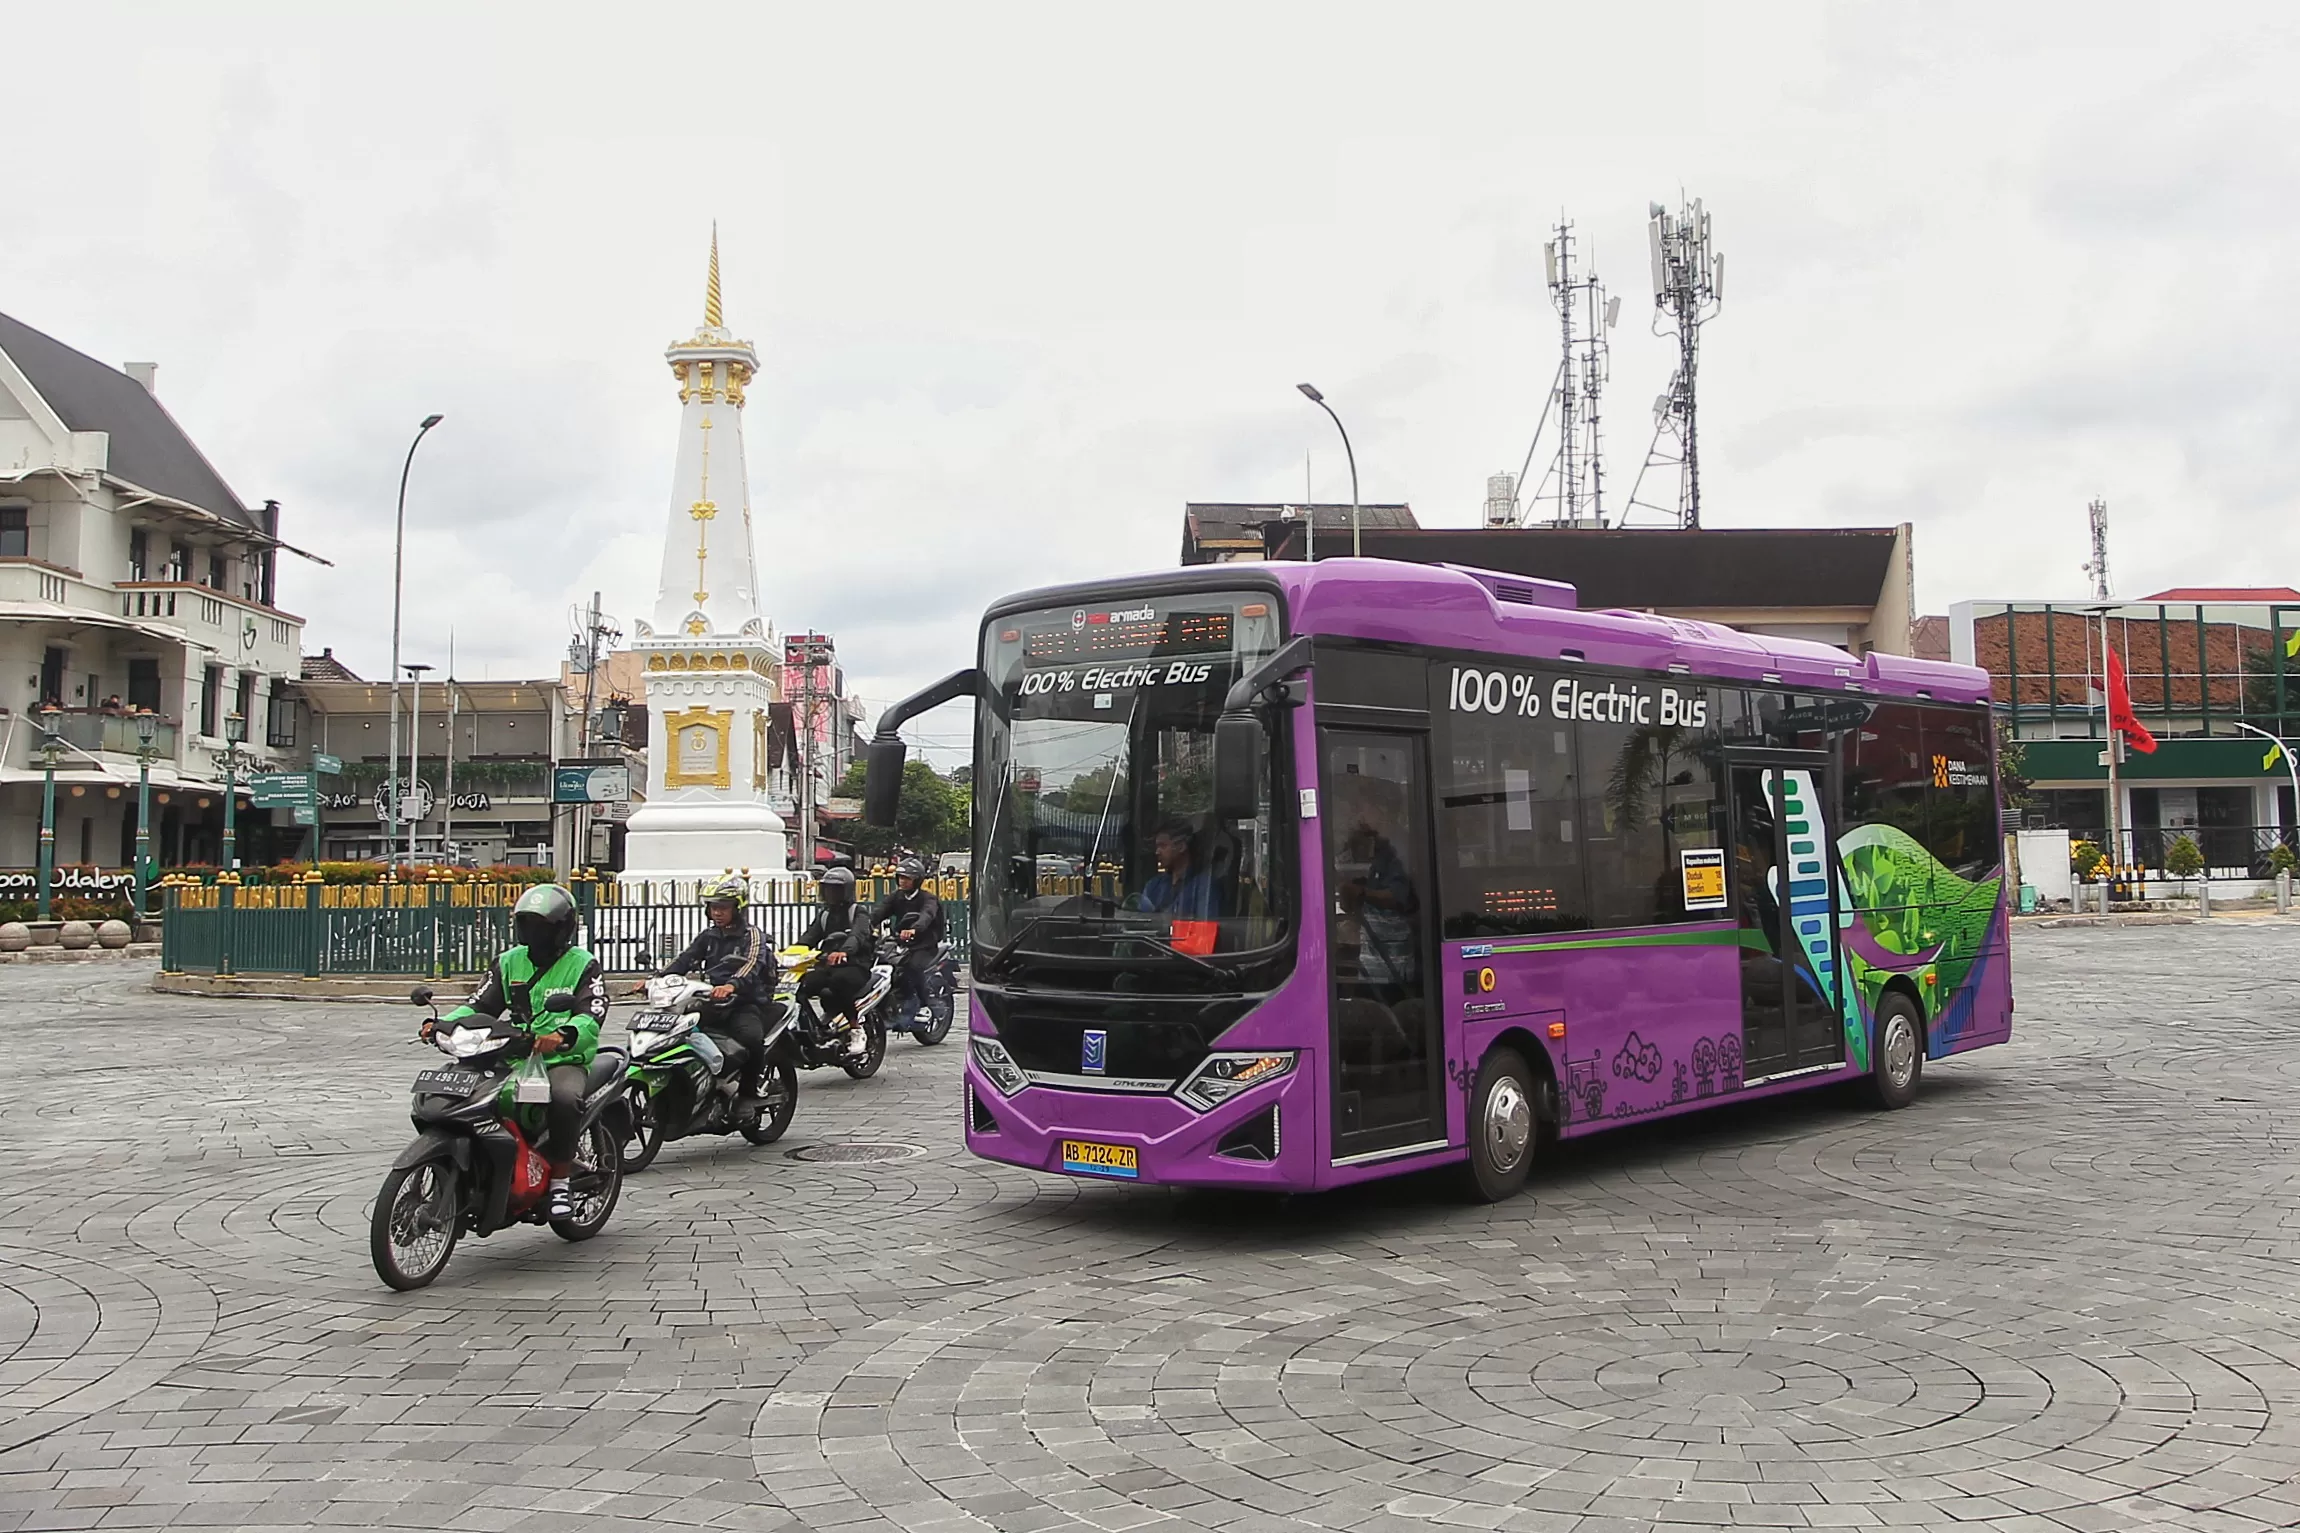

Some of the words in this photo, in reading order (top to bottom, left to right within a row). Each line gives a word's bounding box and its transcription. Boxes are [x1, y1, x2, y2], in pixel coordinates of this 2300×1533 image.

[1110, 604, 1155, 623] armada
[1018, 671, 1075, 696] 100%
[1082, 664, 1161, 690] Electric
[1164, 662, 1212, 685] Bus
[1449, 667, 1540, 717] 100%
[1551, 679, 1650, 725] Electric
[1660, 688, 1707, 728] Bus
[1948, 760, 1966, 772] DANA
[589, 974, 606, 1017] gojek
[419, 1072, 432, 1081] AB
[435, 1072, 458, 1083] 4961
[1113, 1080, 1166, 1089] CITYLANDER
[1065, 1143, 1080, 1161] AB
[1084, 1145, 1114, 1165] 7124
[1119, 1149, 1135, 1168] ZR
